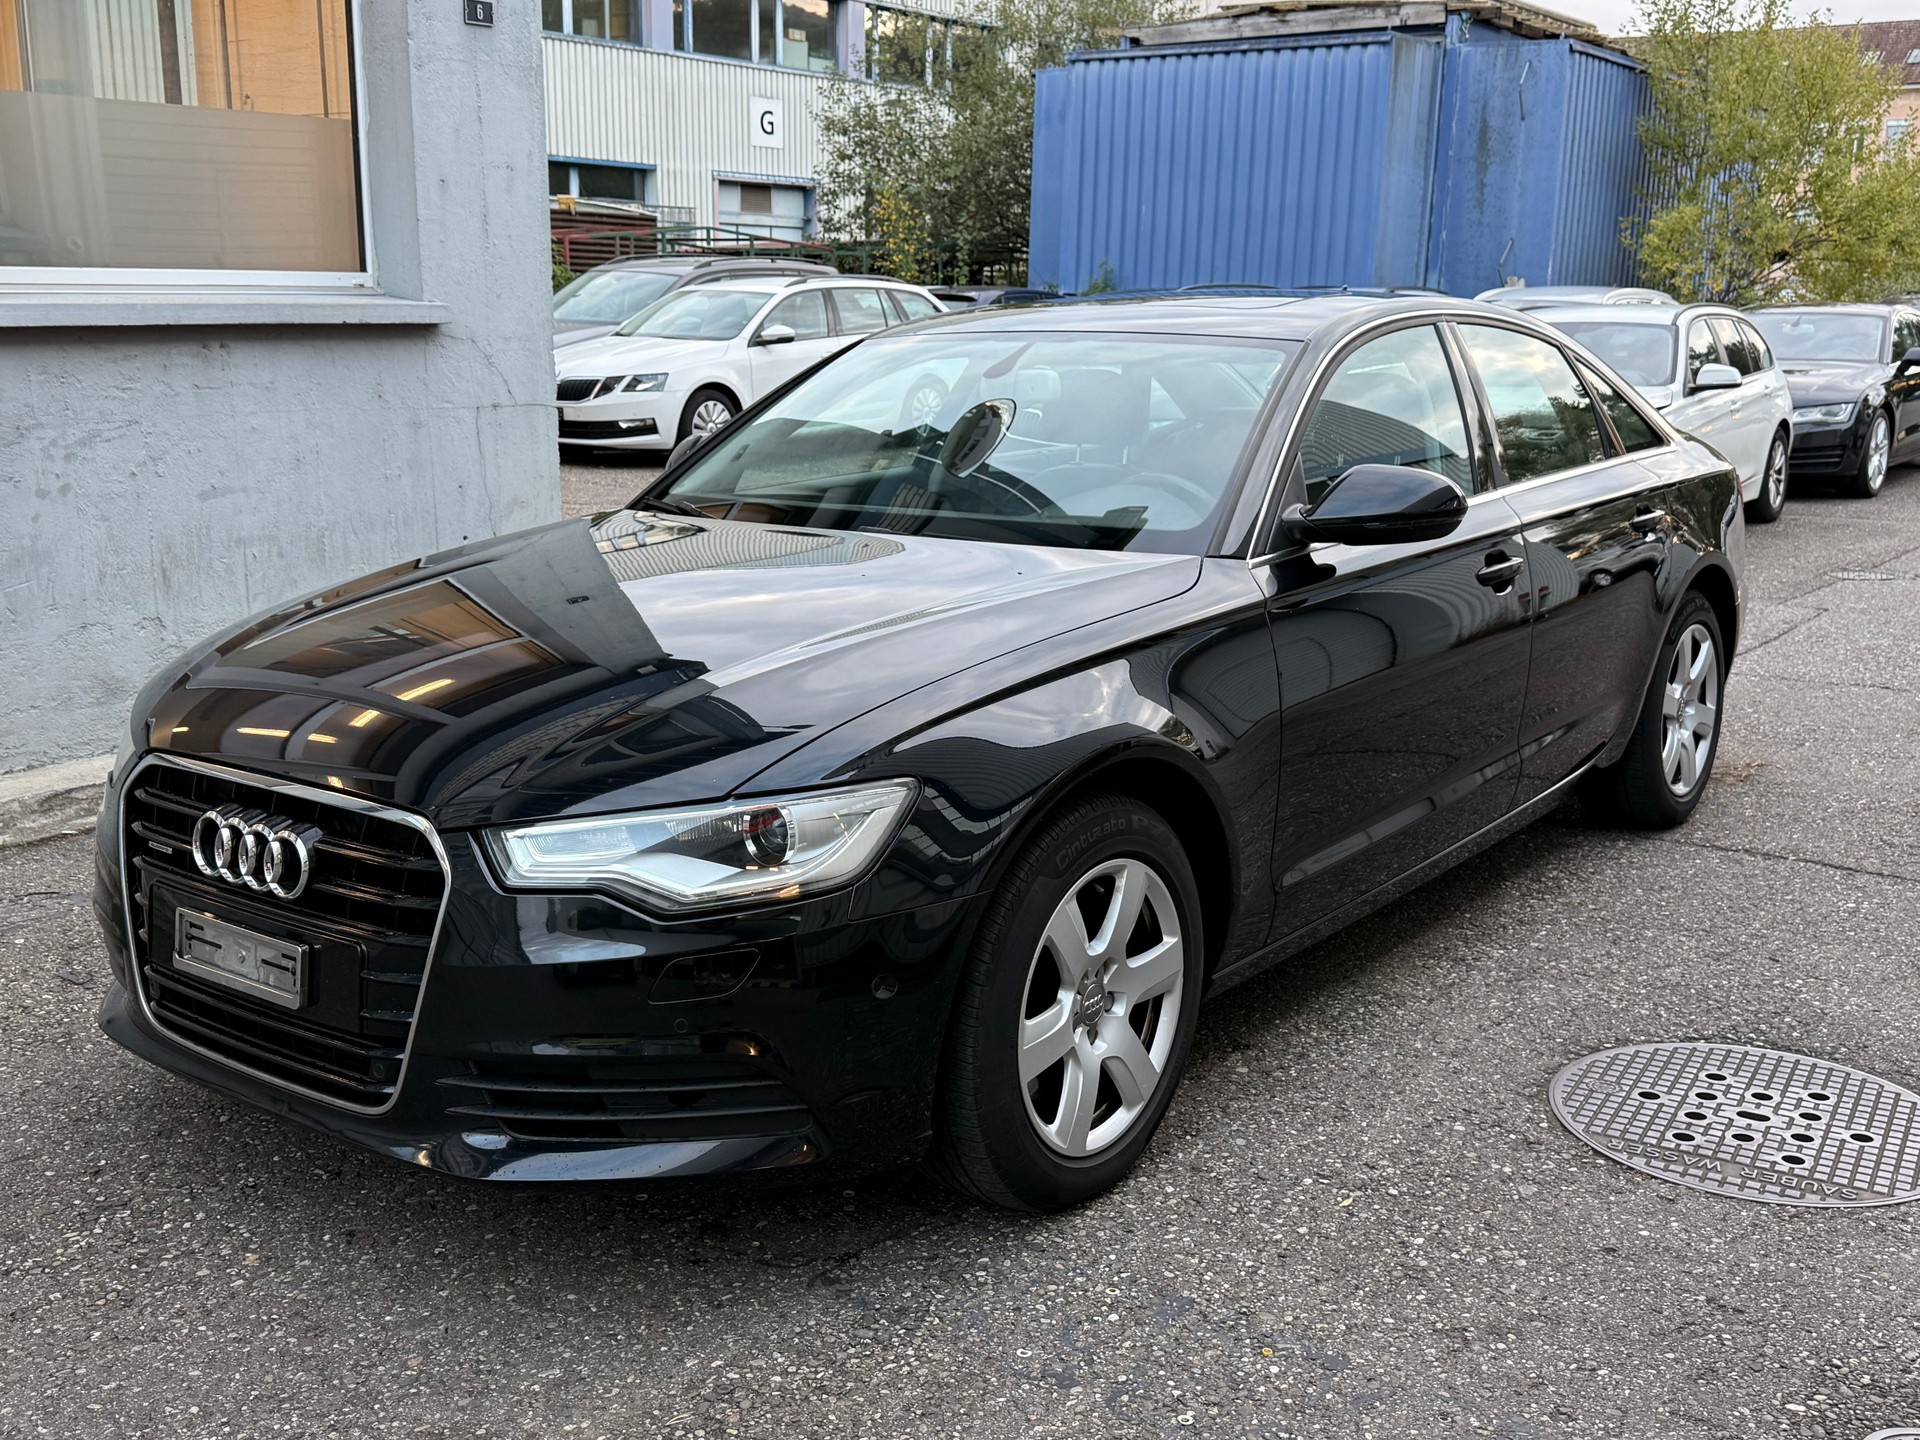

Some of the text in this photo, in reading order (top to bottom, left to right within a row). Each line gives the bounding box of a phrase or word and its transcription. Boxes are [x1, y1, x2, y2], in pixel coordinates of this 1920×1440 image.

[476, 3, 484, 20] 6
[760, 110, 774, 136] G
[1607, 1138, 1859, 1199] SAUBER WASSER
